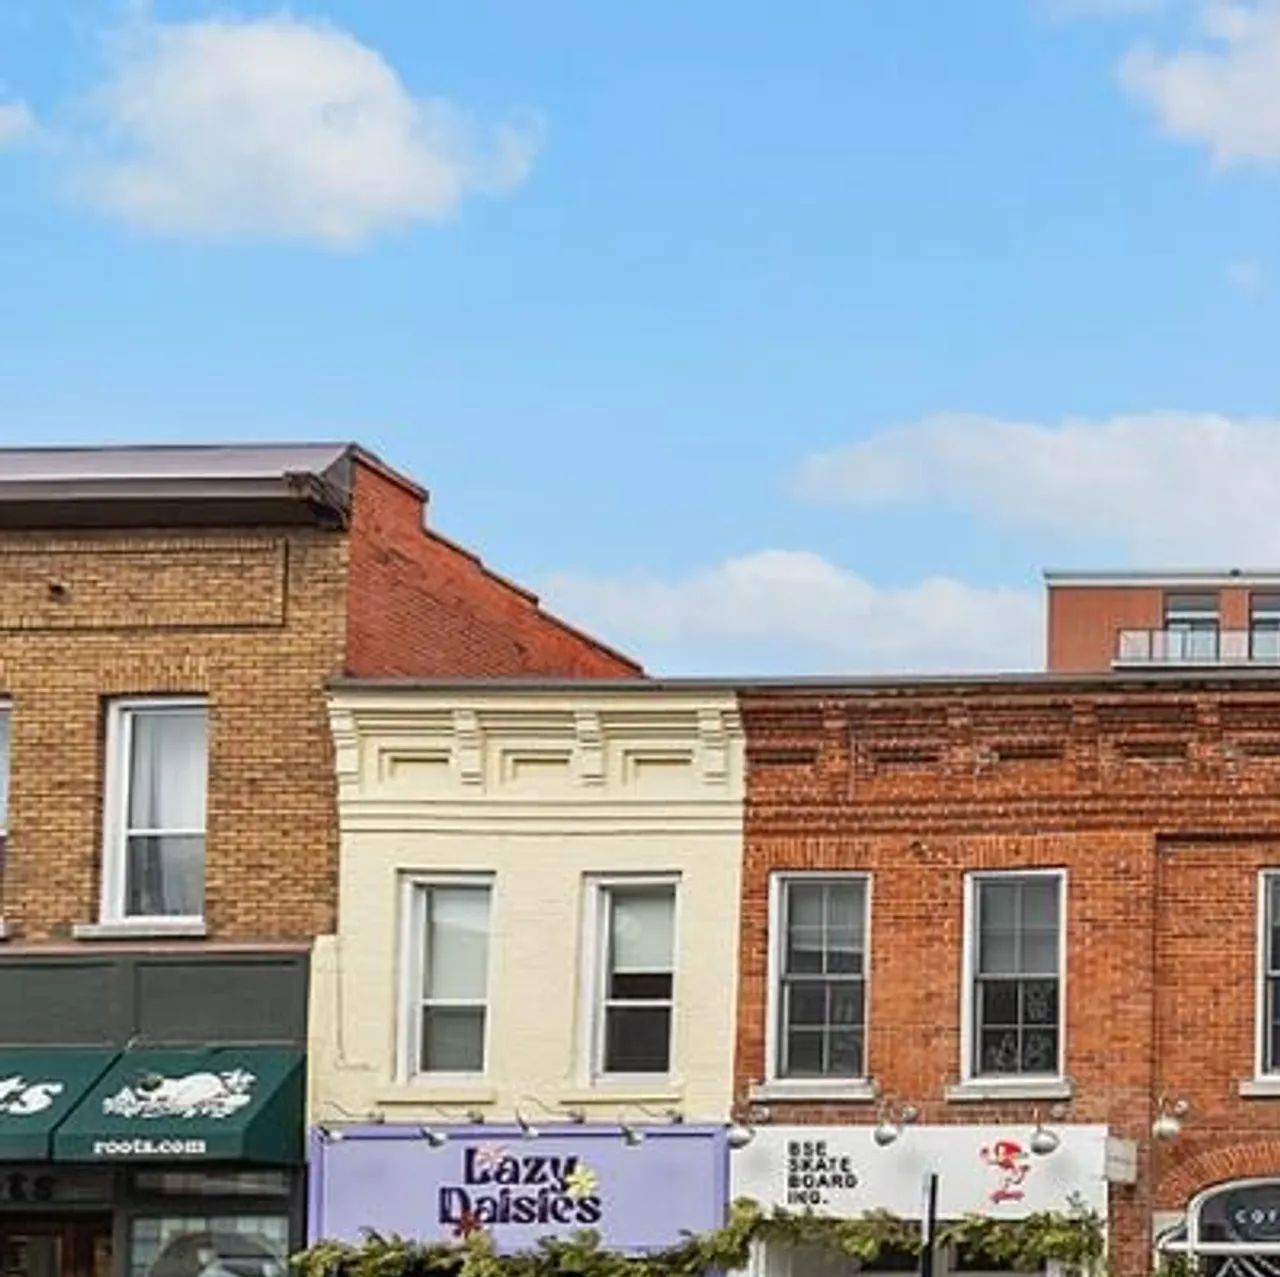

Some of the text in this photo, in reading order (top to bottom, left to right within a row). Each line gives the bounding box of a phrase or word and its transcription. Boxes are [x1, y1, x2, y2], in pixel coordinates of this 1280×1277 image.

[93, 1139, 207, 1154] roots.com
[788, 1142, 828, 1157] BSE
[464, 1148, 578, 1193] Lazy
[788, 1158, 851, 1173] SKATE
[788, 1174, 859, 1189] BOARD
[438, 1185, 602, 1224] Daisies
